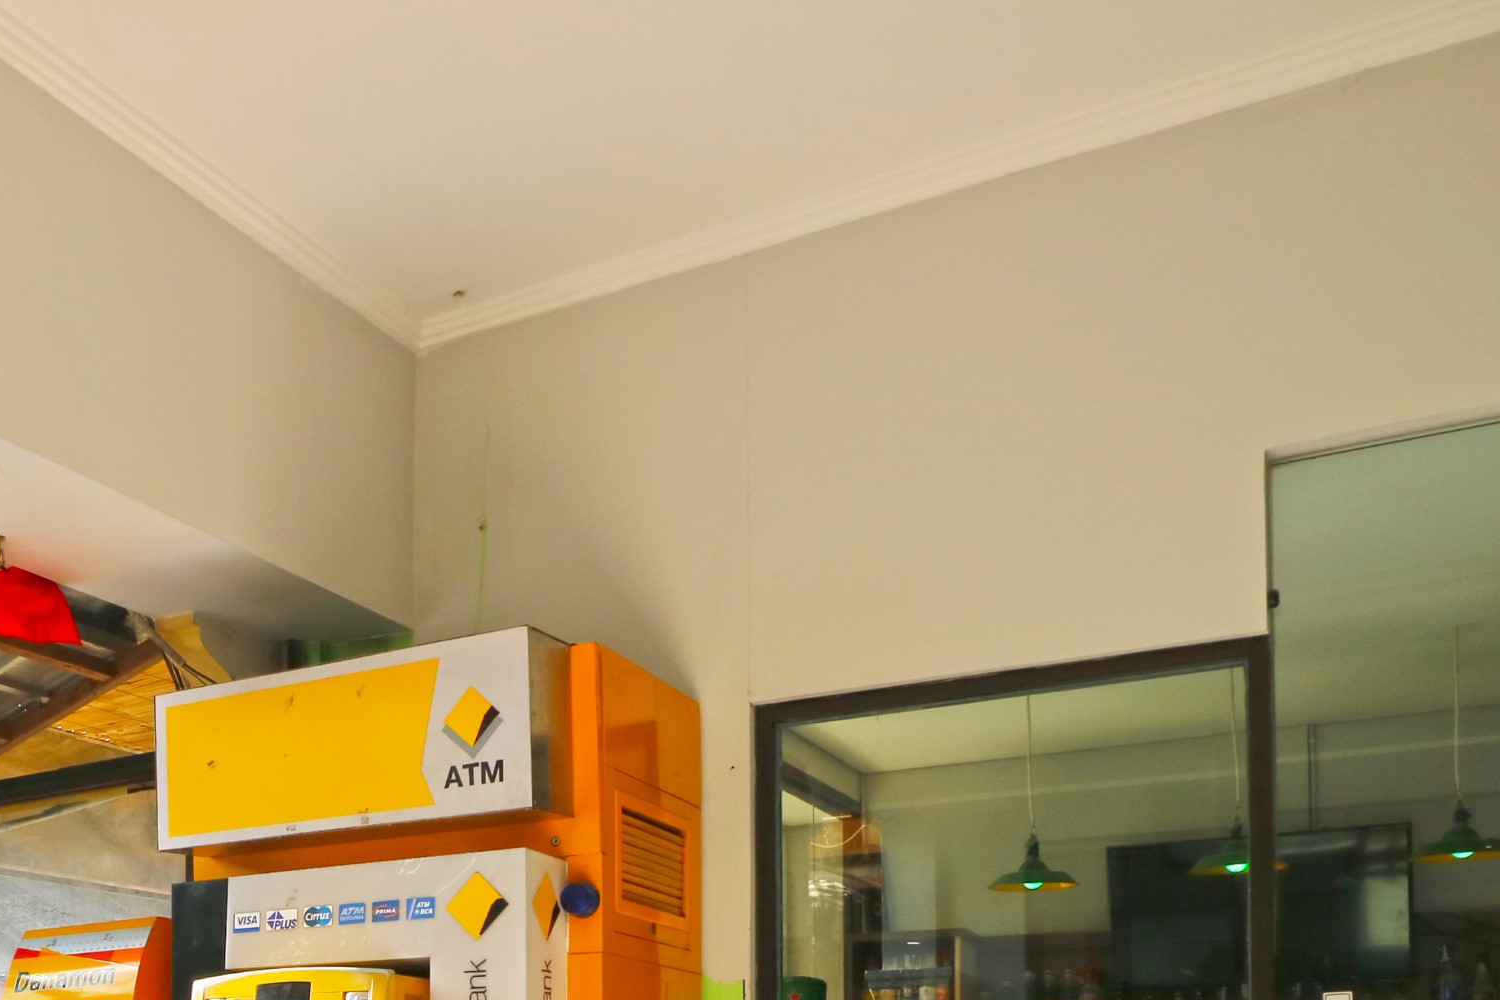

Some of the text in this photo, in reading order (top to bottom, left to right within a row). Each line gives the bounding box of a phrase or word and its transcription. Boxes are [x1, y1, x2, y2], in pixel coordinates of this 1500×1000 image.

[444, 759, 504, 789] ATM
[340, 905, 365, 916] ATM
[417, 901, 430, 909] ATM
[305, 911, 330, 922] Cirrus
[375, 907, 397, 915] PRIMA
[237, 915, 258, 926] VISA
[274, 919, 298, 931] PLUS
[14, 966, 117, 993] Danamon
